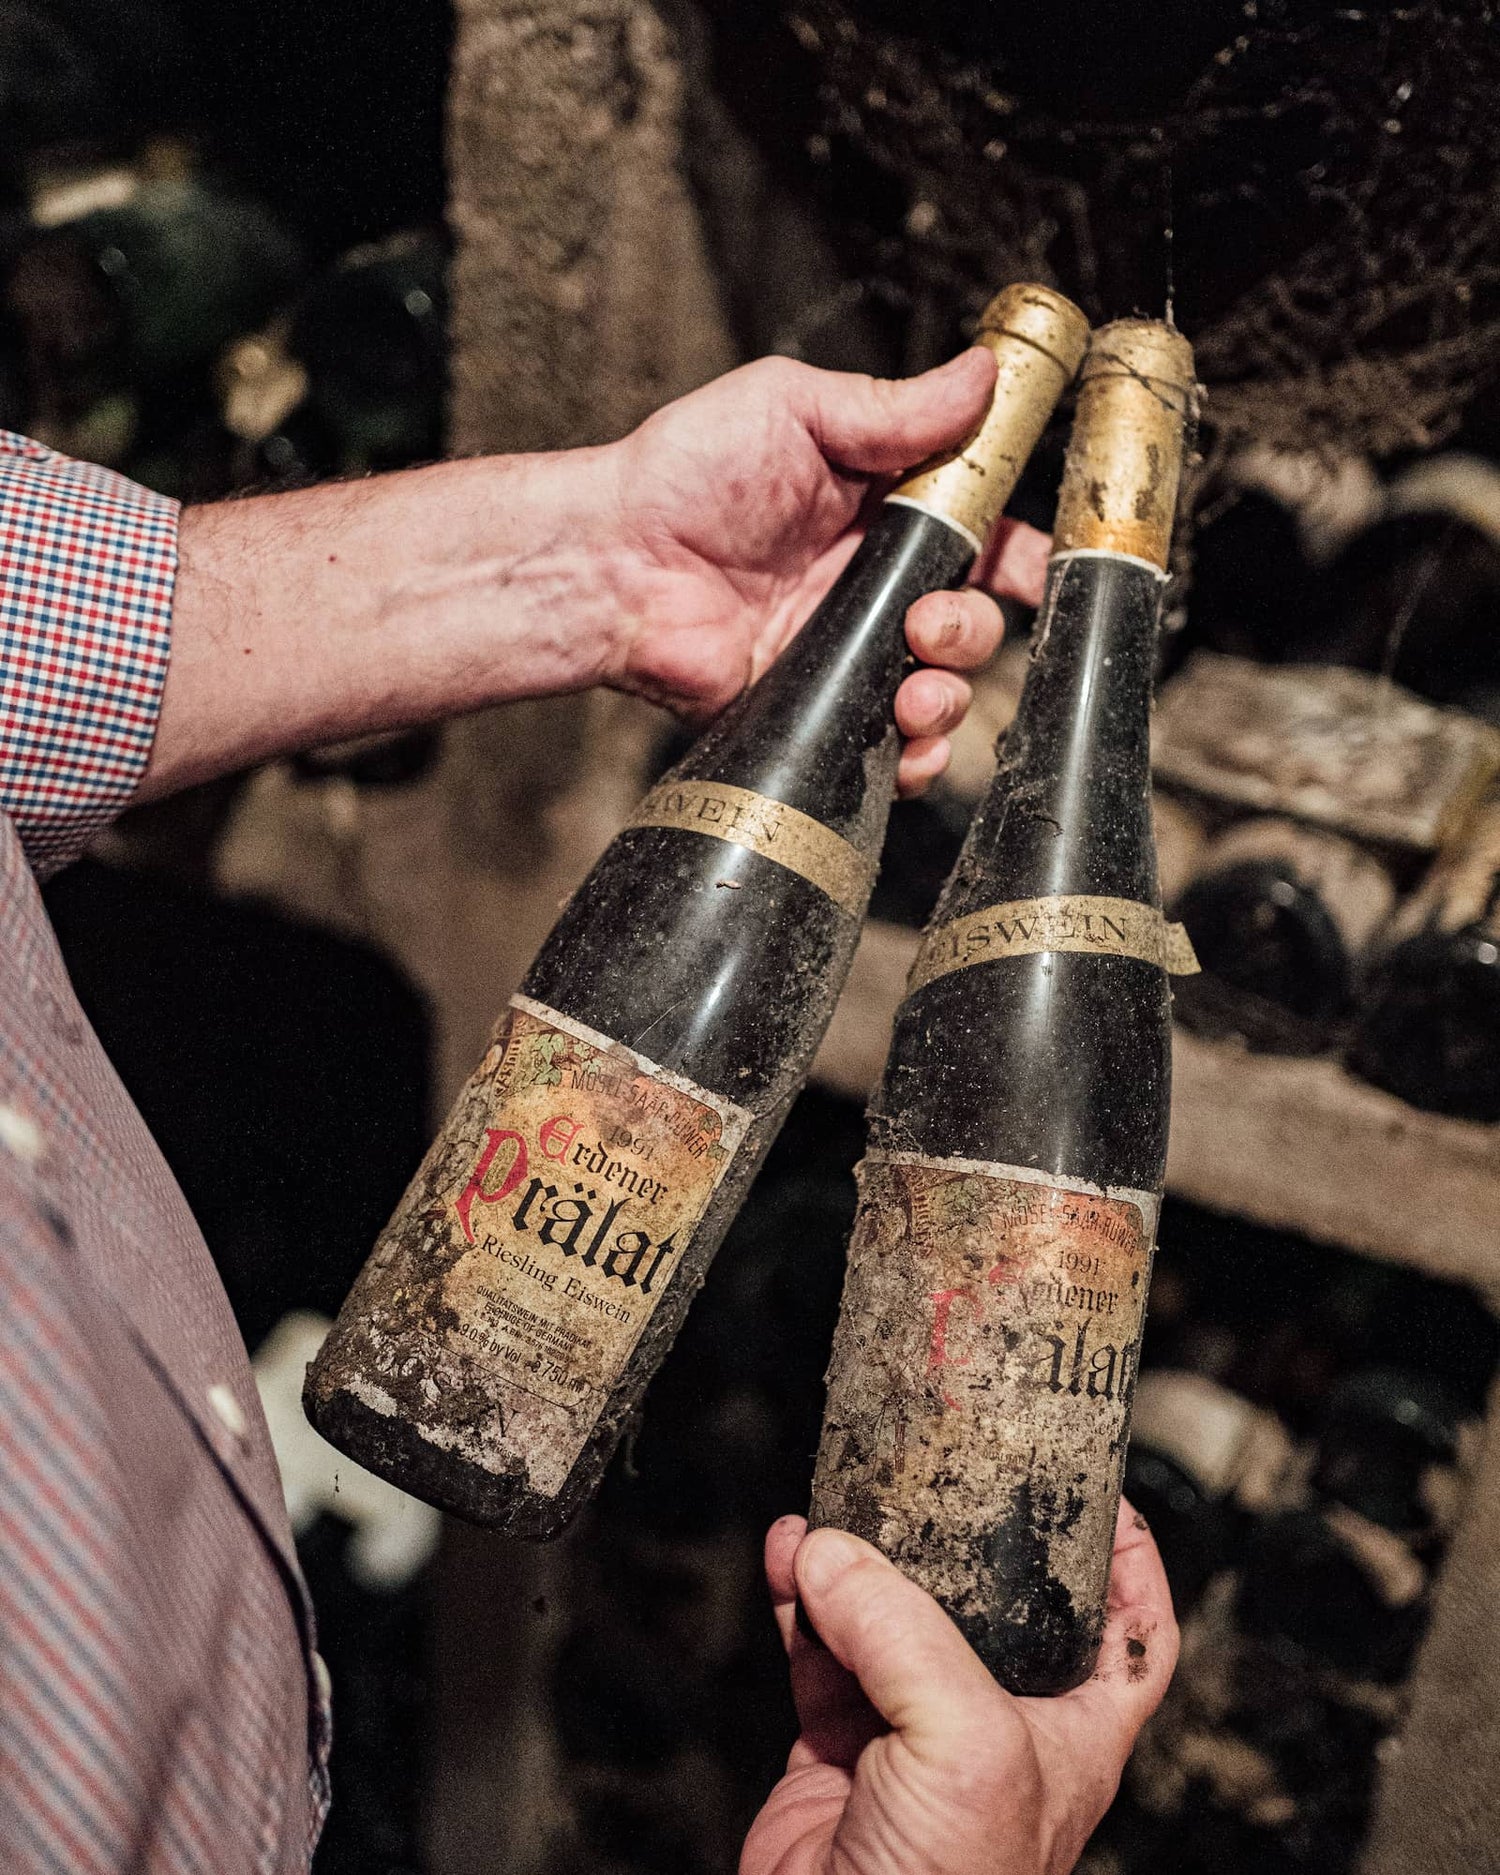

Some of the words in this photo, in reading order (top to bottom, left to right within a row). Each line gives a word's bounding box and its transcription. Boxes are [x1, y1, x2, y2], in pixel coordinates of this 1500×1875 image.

[539, 1115, 669, 1205] Erdener
[609, 1125, 653, 1161] 1991
[453, 1127, 682, 1295] Prälat
[481, 1233, 559, 1292] Riesling
[562, 1276, 632, 1324] Eiswein
[1057, 1251, 1100, 1276] 1991
[489, 1339, 505, 1356] by
[542, 1360, 568, 1385] 750
